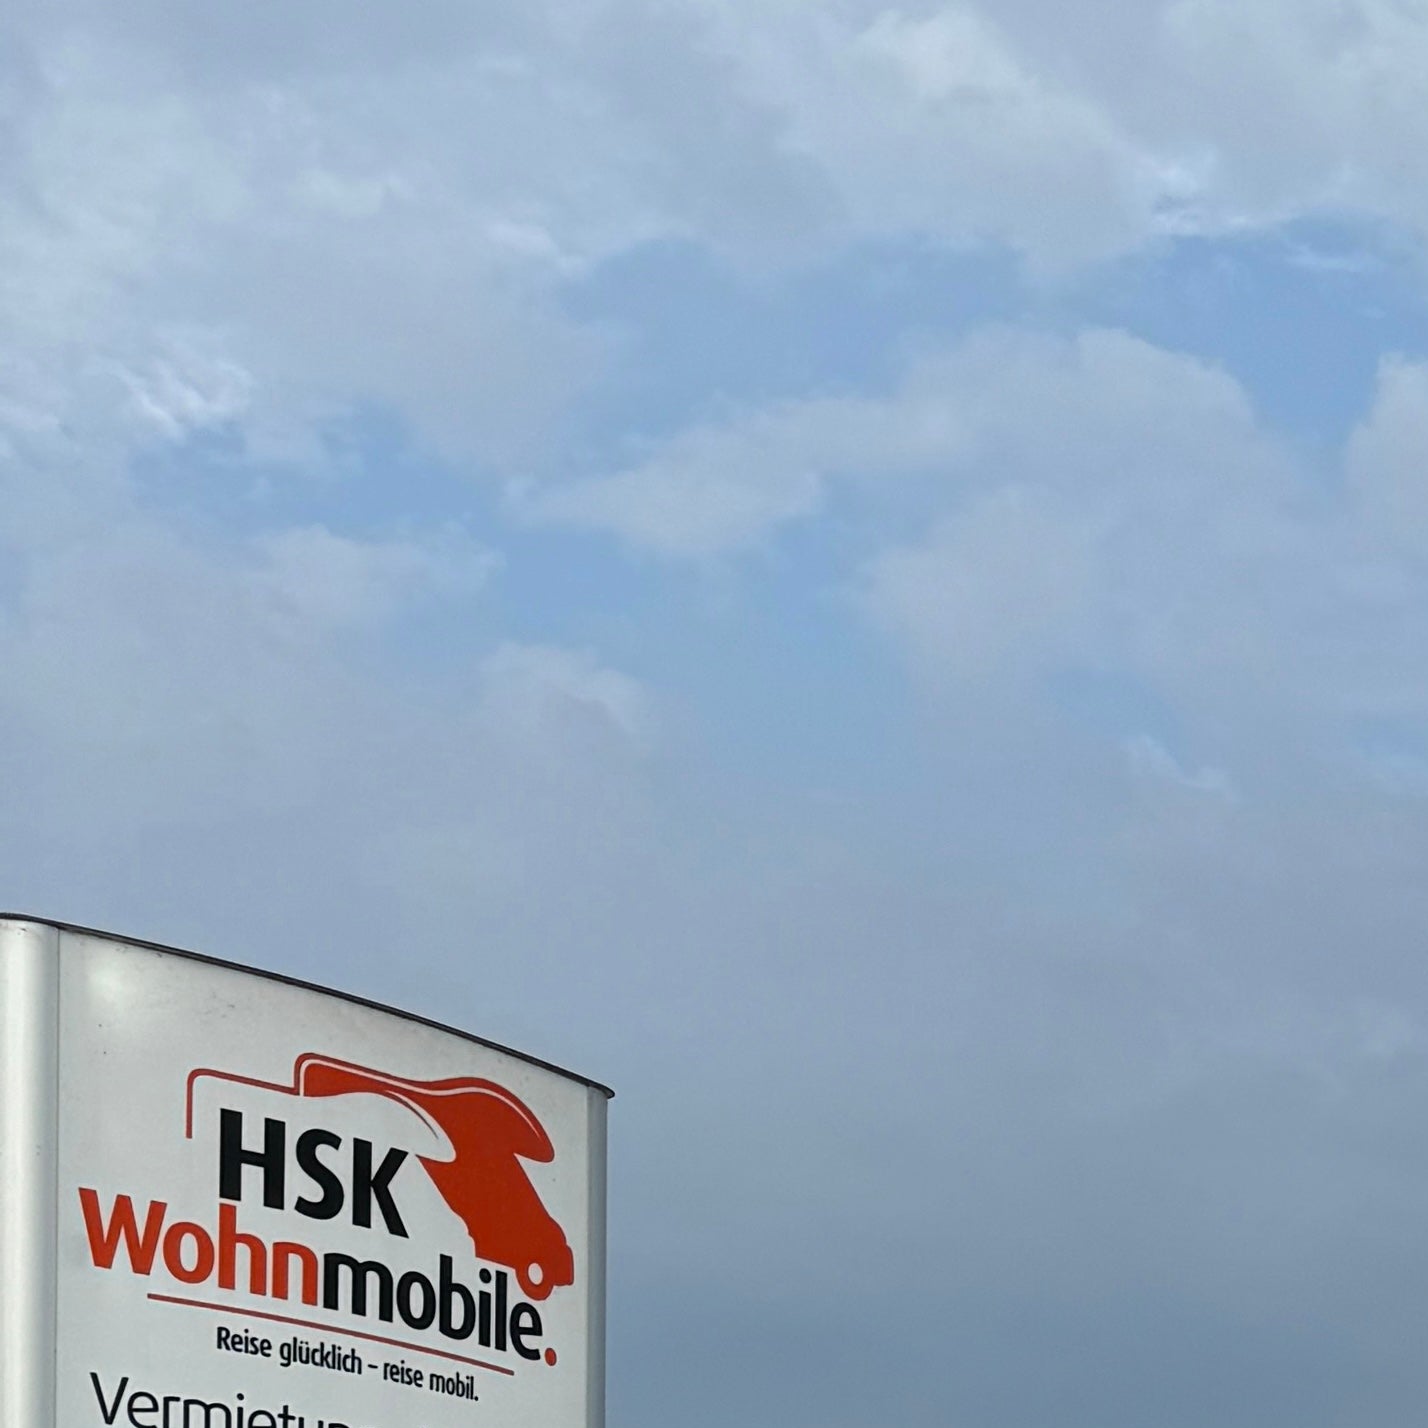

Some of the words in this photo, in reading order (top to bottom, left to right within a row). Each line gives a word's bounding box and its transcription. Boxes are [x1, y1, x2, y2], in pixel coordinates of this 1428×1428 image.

[219, 1107, 410, 1239] HSK
[216, 1326, 272, 1357] Reise
[279, 1335, 362, 1376] glücklich
[382, 1361, 424, 1391] reise
[429, 1369, 479, 1402] mobil.
